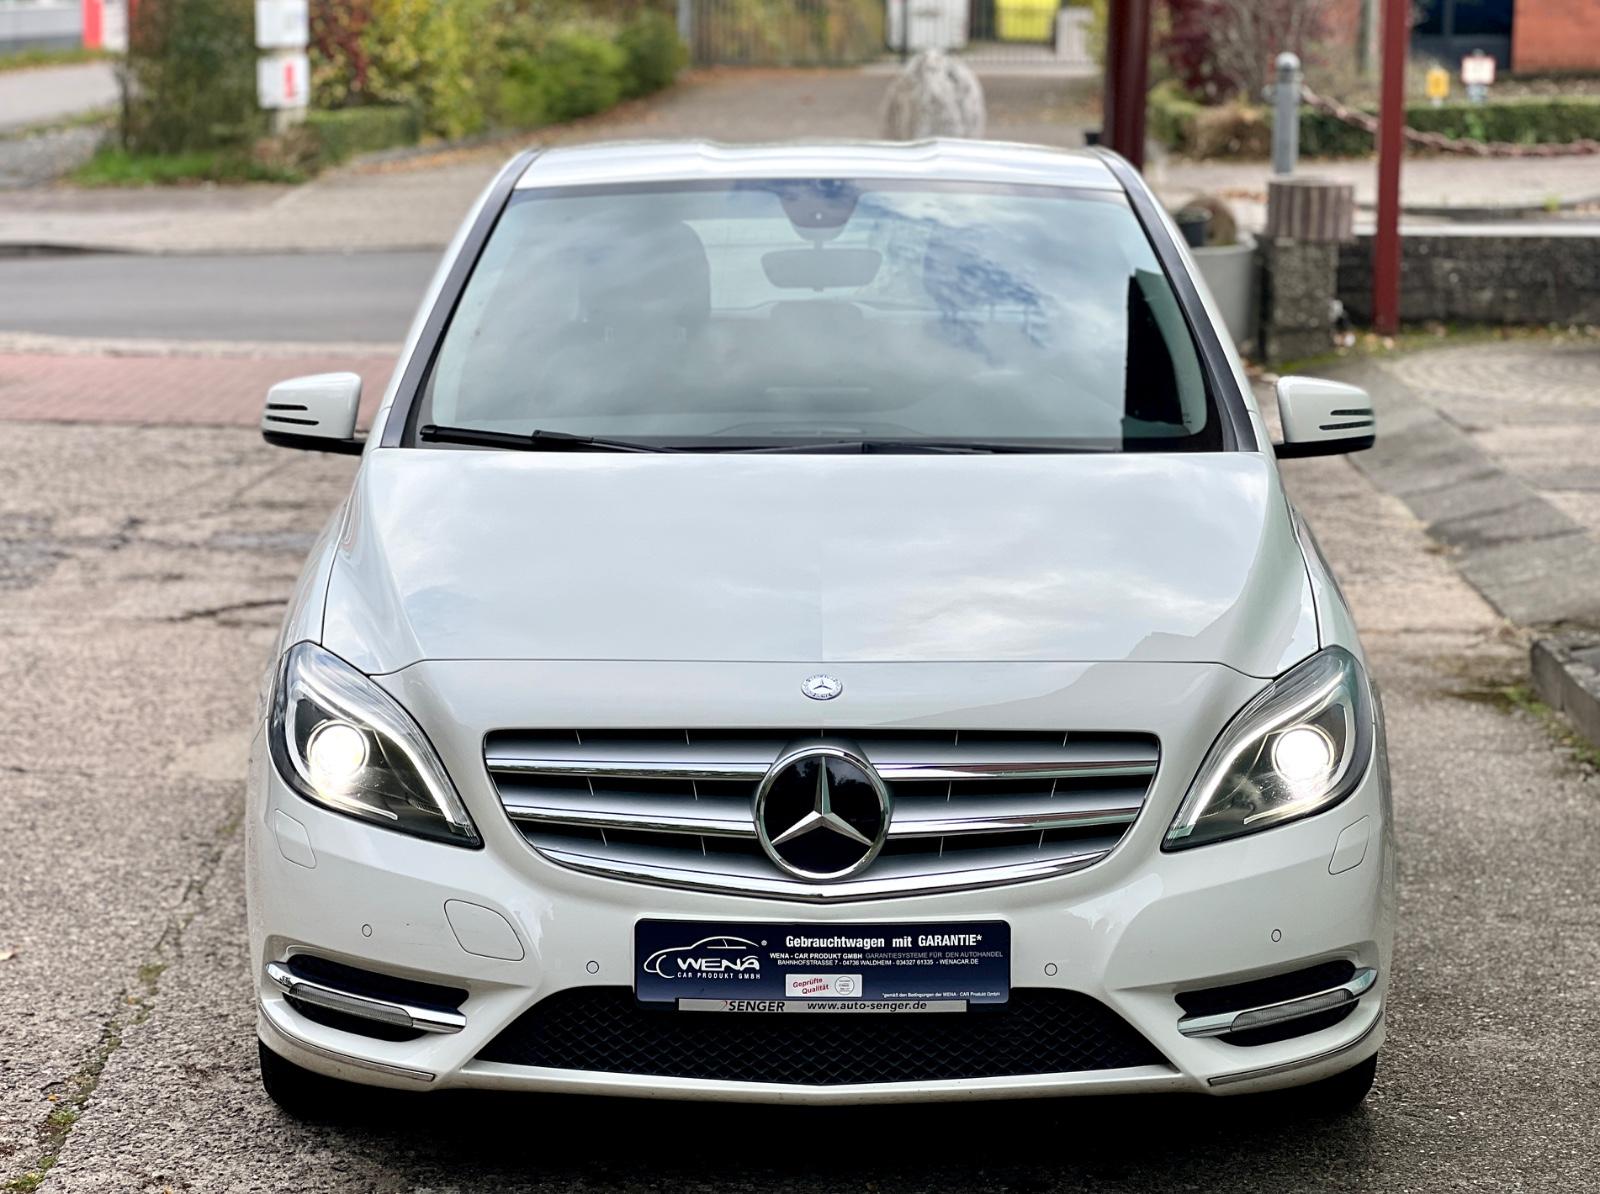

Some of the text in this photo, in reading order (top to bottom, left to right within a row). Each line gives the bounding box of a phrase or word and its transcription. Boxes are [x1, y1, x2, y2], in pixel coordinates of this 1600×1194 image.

[785, 935, 885, 950] Gebrauchtwagen
[892, 936, 912, 948] mit
[864, 952, 928, 960] GARANTIESYSTEME
[792, 977, 823, 989] Geprüfte
[801, 984, 830, 995] Qualität
[728, 1001, 928, 1013] SENGER www.auto-senger.de
